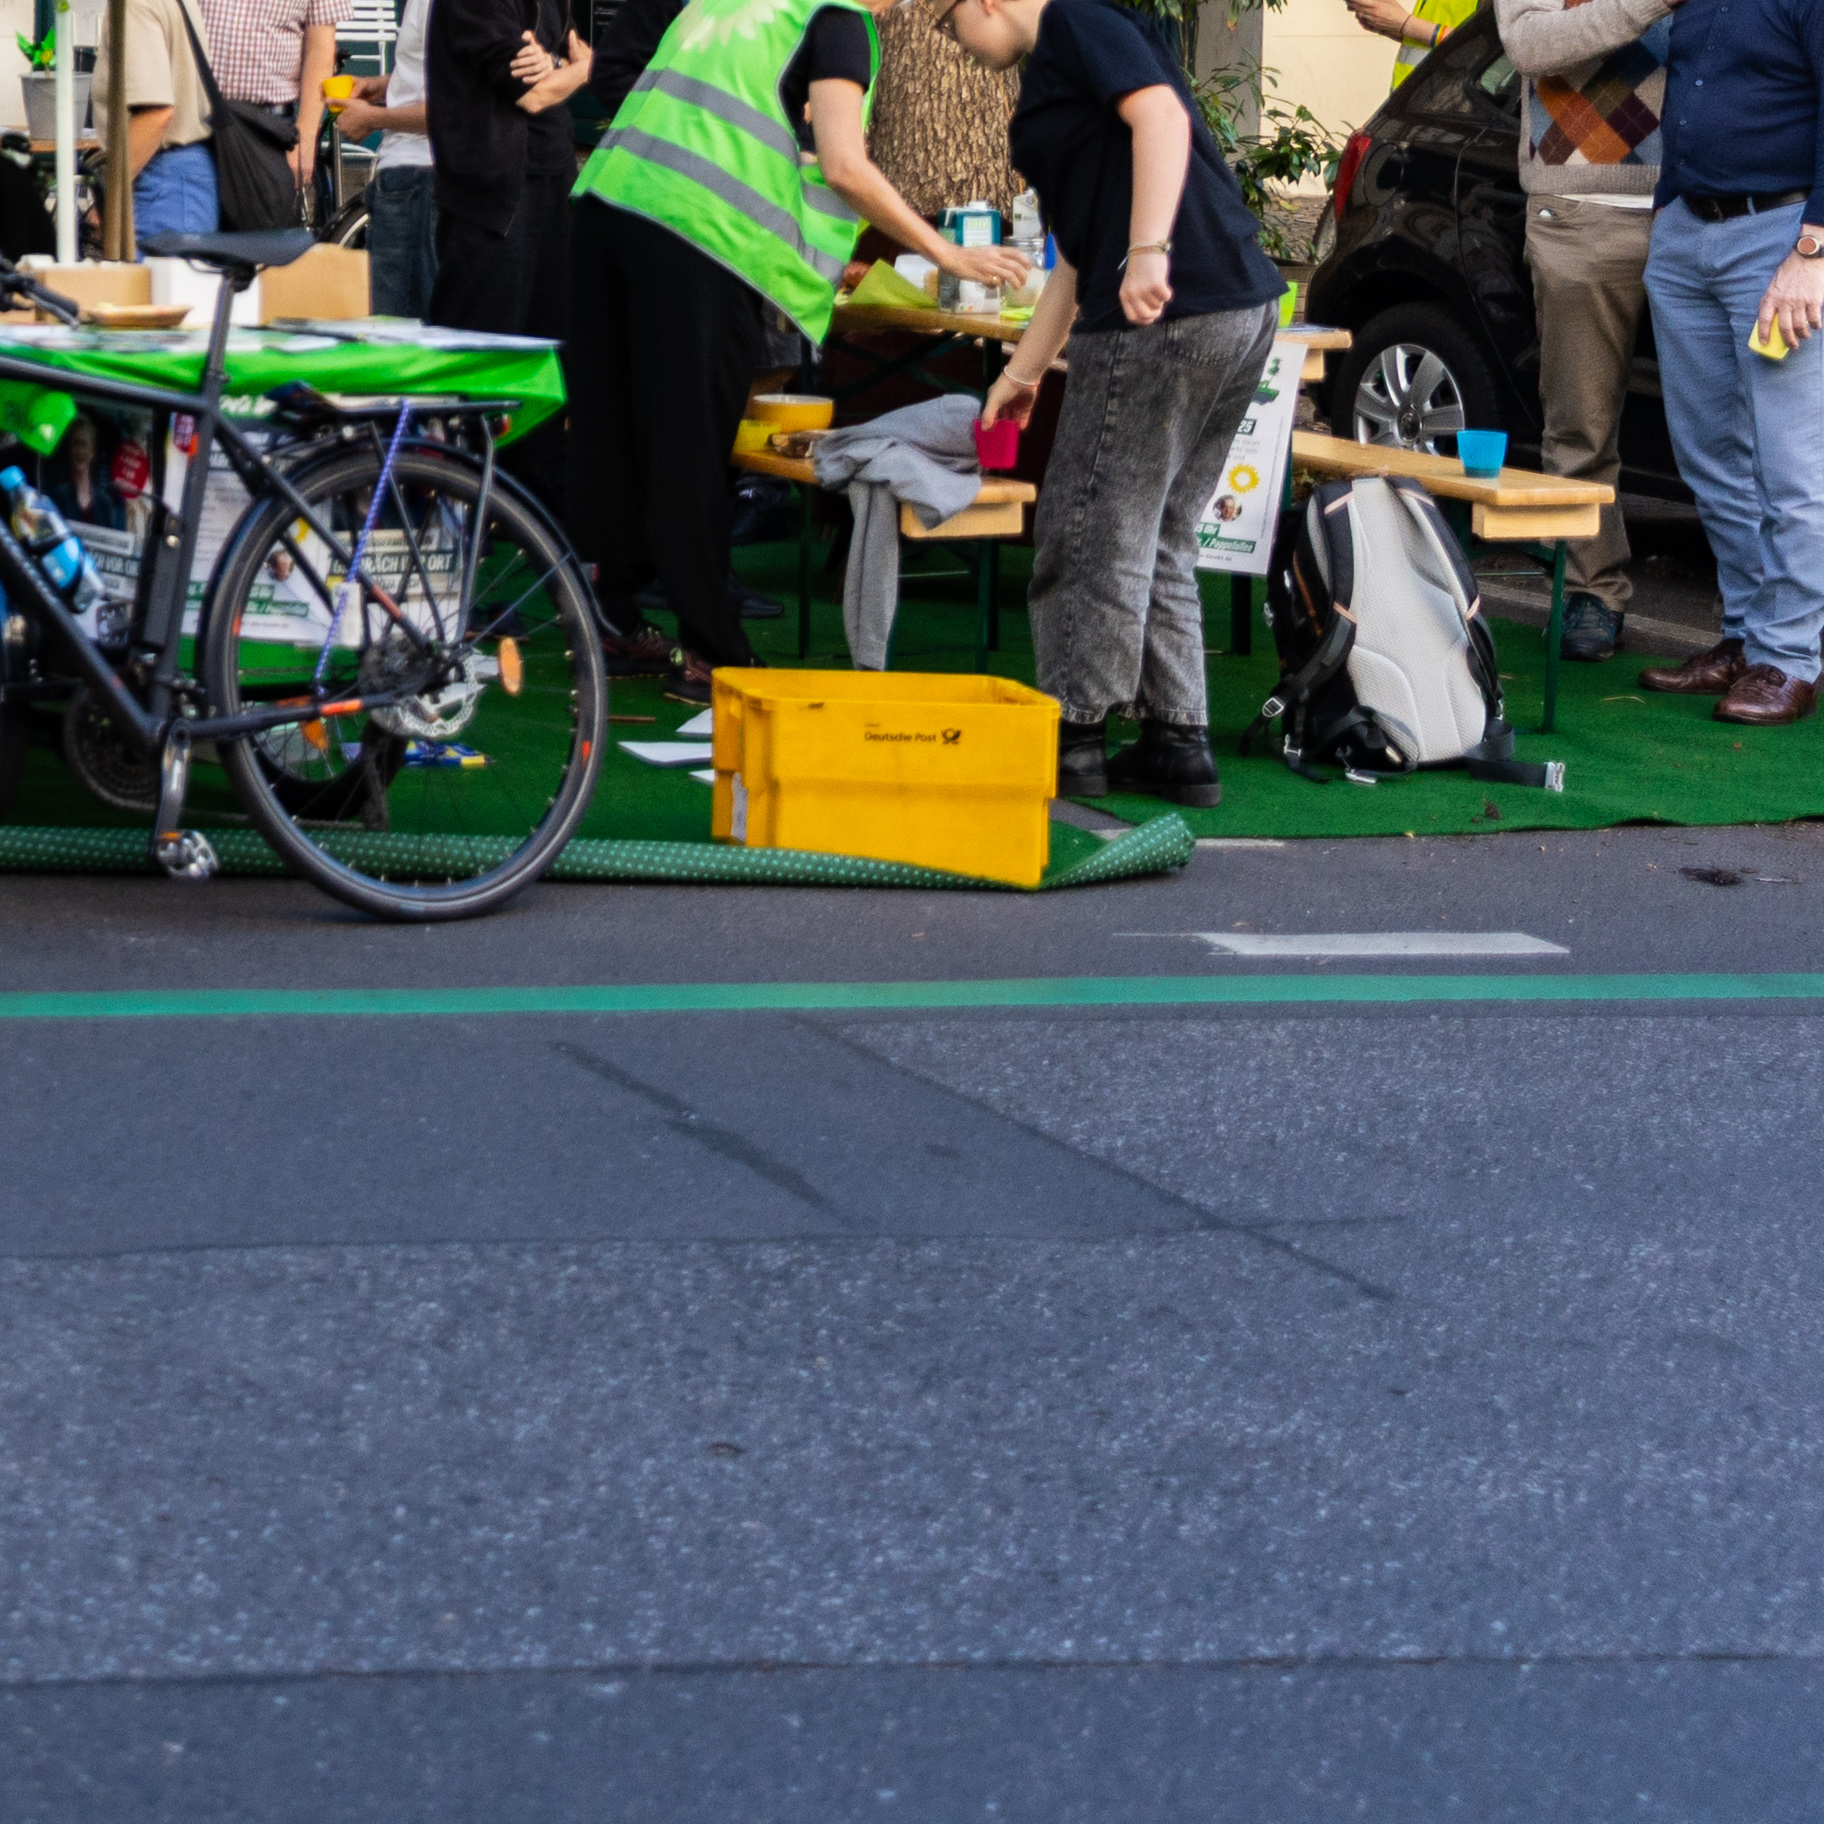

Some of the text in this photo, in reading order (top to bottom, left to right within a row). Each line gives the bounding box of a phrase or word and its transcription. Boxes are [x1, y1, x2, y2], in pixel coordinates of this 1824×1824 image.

[1236, 419, 1254, 434] 25
[427, 553, 453, 571] ORT
[864, 731, 936, 742] Deutsche Post
